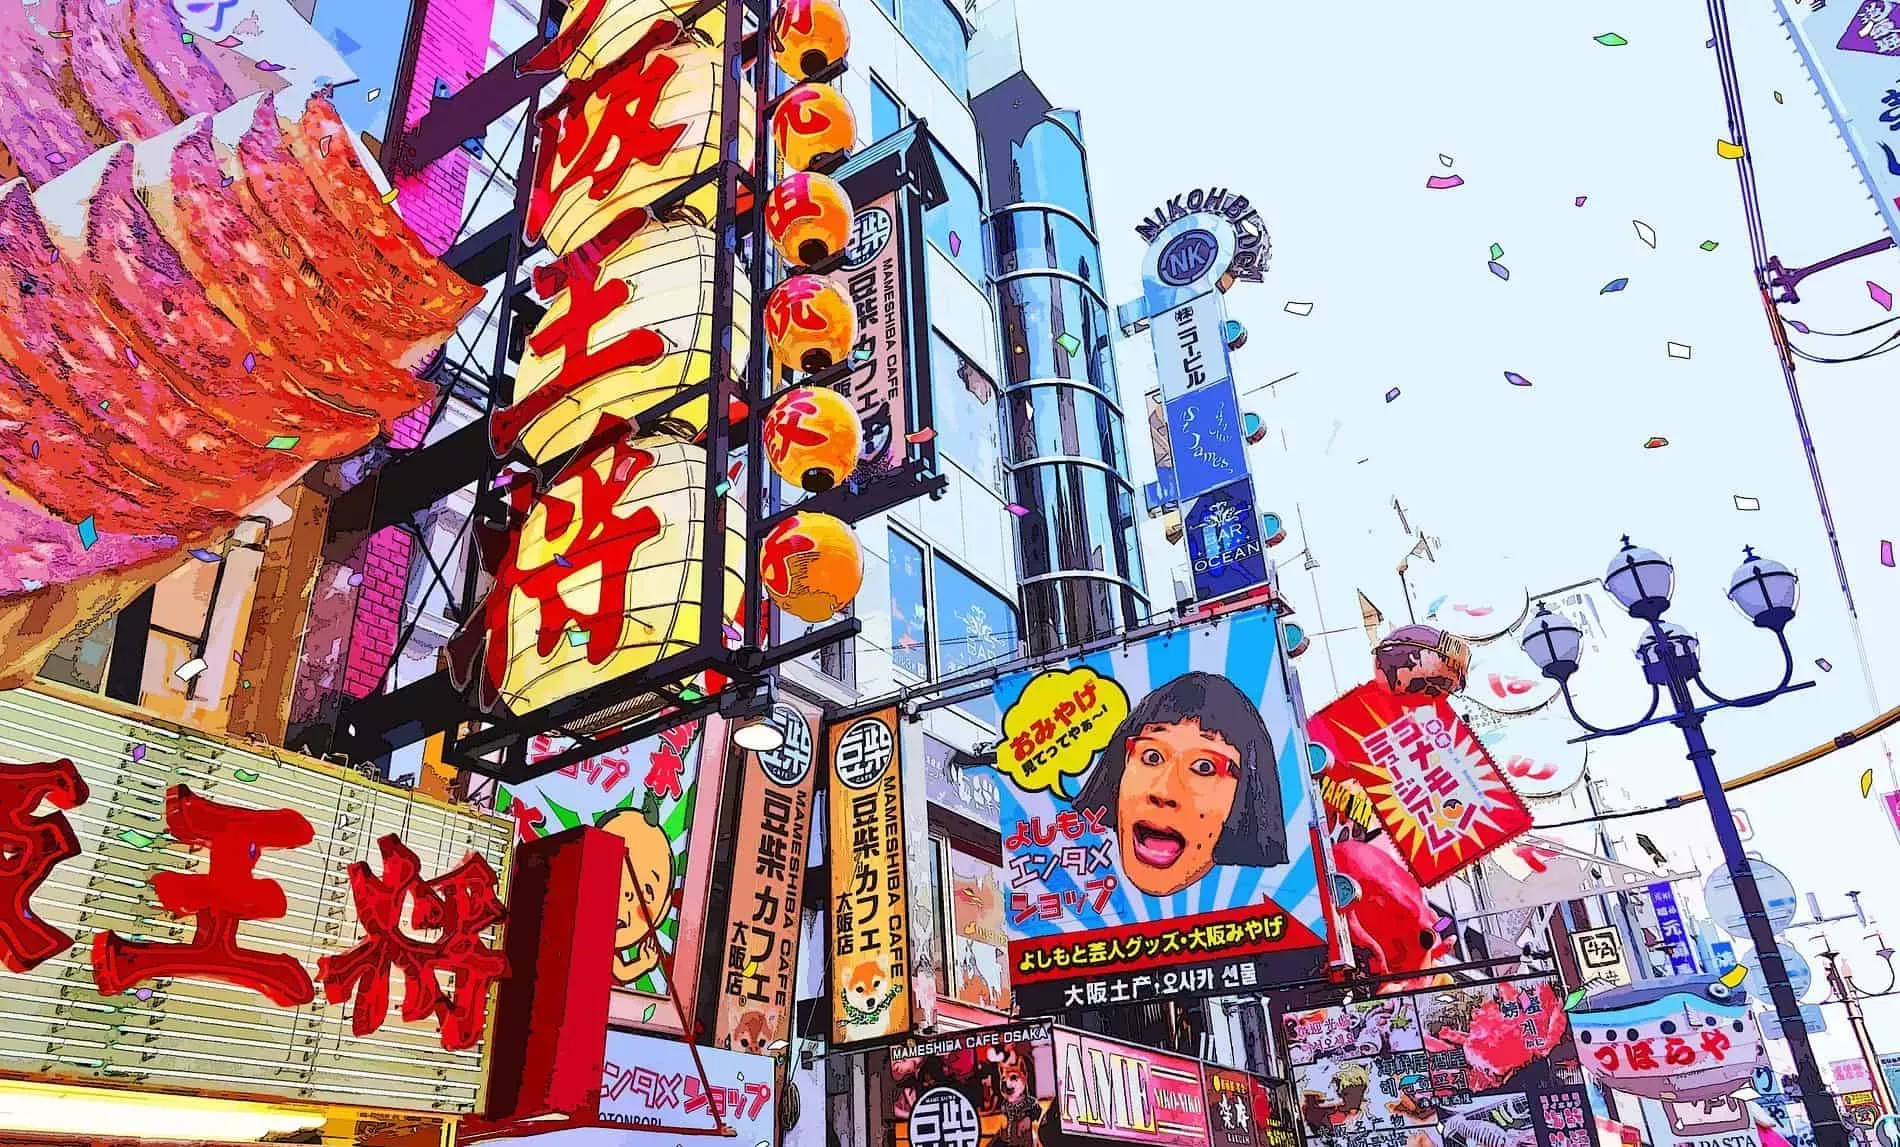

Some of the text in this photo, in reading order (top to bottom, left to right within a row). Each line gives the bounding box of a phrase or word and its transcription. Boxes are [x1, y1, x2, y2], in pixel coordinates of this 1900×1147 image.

[1168, 243, 1206, 276] NK
[882, 257, 899, 402] MAMESHIBA CAFE
[1194, 540, 1262, 573] OCEAN
[1009, 680, 1099, 763] おみやげ
[1005, 804, 1109, 851] よしもと
[1363, 731, 1456, 851] ミュージアム
[748, 787, 793, 1004] 豆柴カフェ
[774, 789, 808, 1009] MAMESHIBA CAFE
[851, 791, 883, 952] 豆柴カフェ
[883, 773, 905, 979] MAMESHIBA CAFE
[1008, 838, 1114, 889] エンタメ
[1010, 874, 1119, 925] ショップ
[835, 892, 854, 957] 大阪店
[1019, 915, 1288, 972] よしもと芸人グッズ・大阪みやげ
[893, 1026, 1051, 1061] MAMESHIBA CAFE OSAKA
[1062, 1043, 1157, 1134] AME
